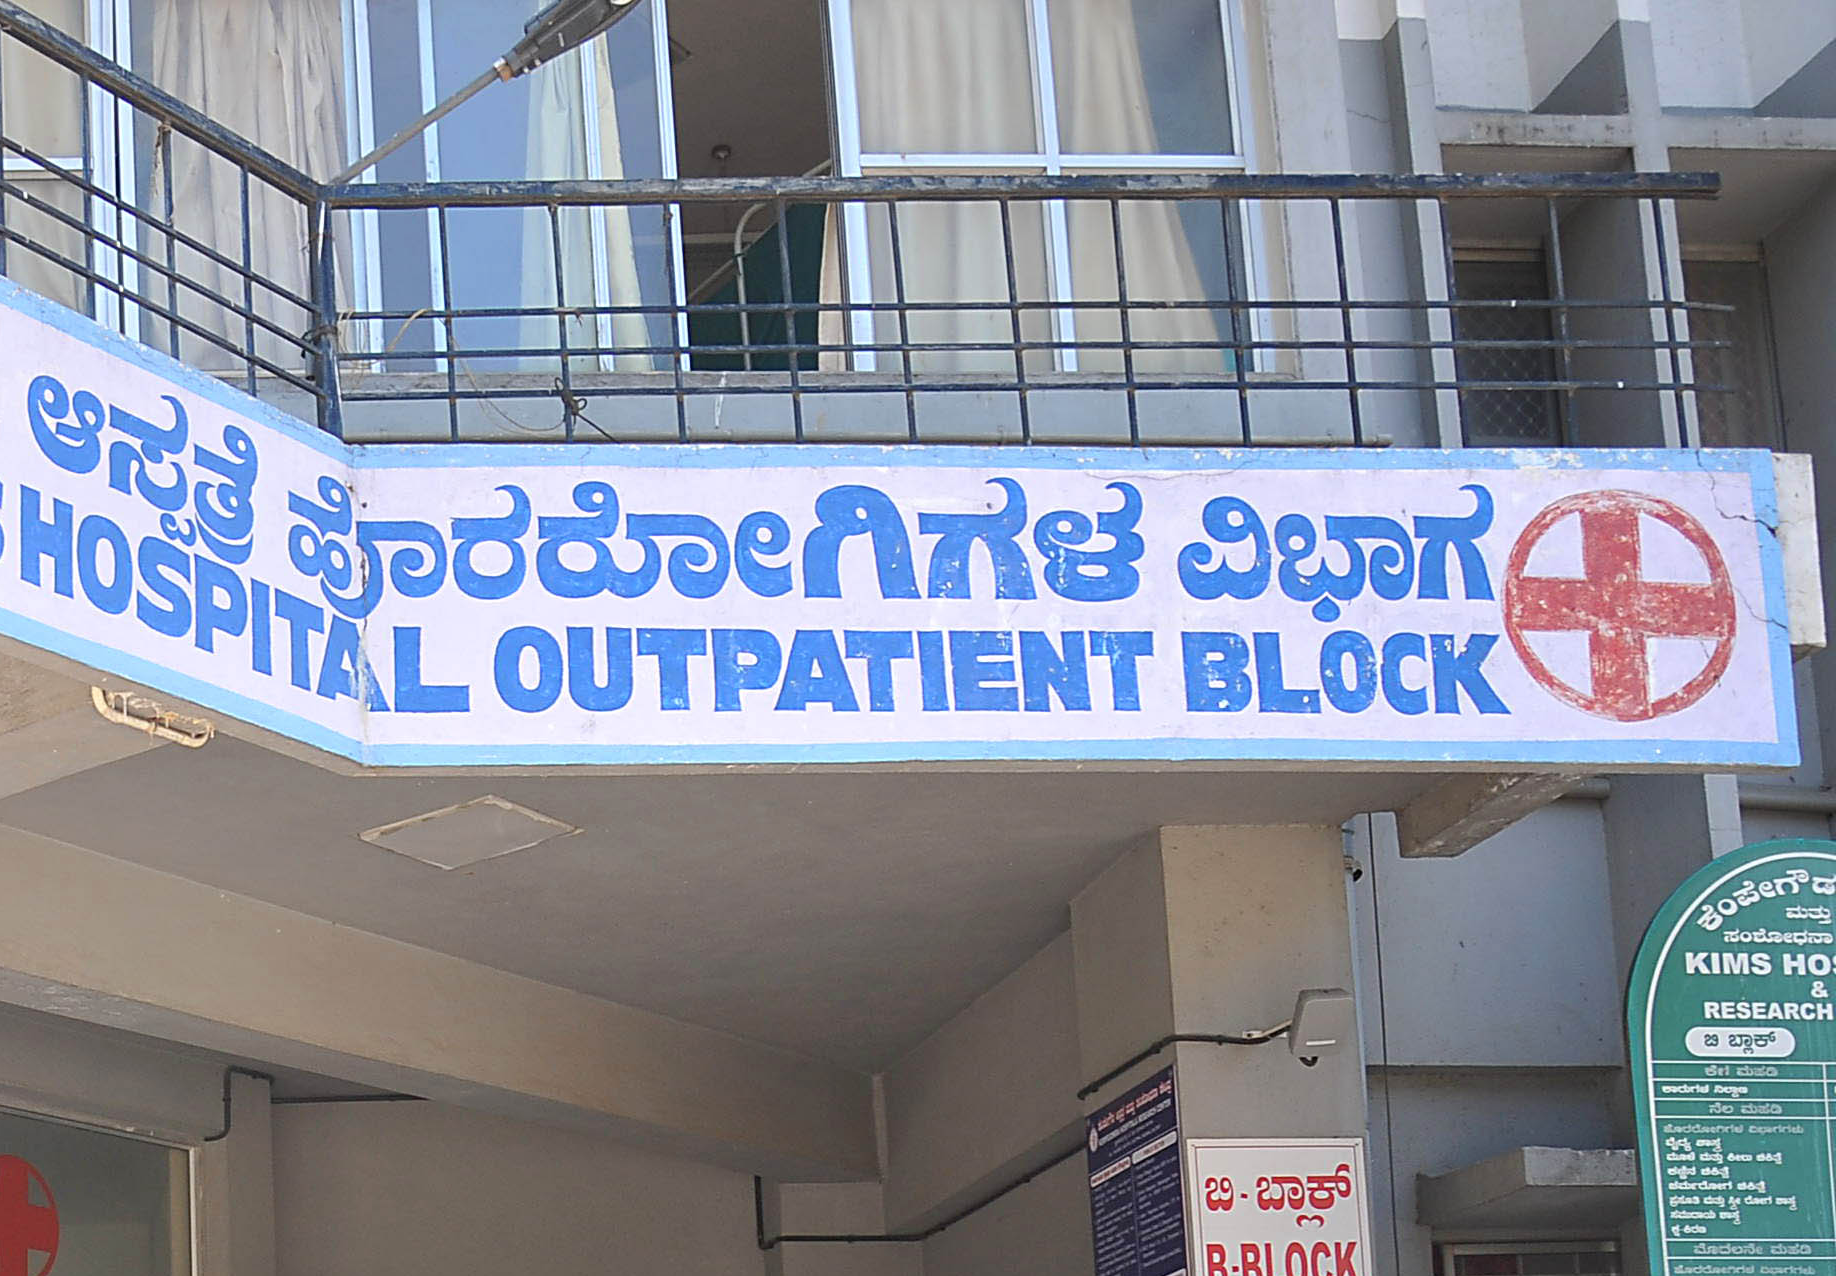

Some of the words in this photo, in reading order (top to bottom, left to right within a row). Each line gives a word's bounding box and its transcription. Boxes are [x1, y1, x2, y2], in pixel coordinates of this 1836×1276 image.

[28, 376, 258, 565] ಆಸ್ಪತ್ರೆ
[288, 476, 1146, 619] ಹೊರರೋಗಿಗಳ
[1177, 484, 1495, 622] ವಿಭಾಗ
[20, 484, 470, 713] HOSPITAL
[494, 626, 1154, 713] OUTPATIENT
[1181, 630, 1511, 715] BLOCK
[1786, 905, 1832, 924] ಮತ್ತು
[1723, 928, 1834, 945] ಸಂಶೋಧನಾ
[1685, 952, 1772, 975] KIMS
[1783, 953, 1836, 976] HO
[1810, 981, 1829, 998] &
[1704, 1001, 1834, 1020] RESEARCH
[1704, 1033, 1718, 1047] ಬಿ
[1728, 1031, 1776, 1054] ಬ್ಲಾಕ್
